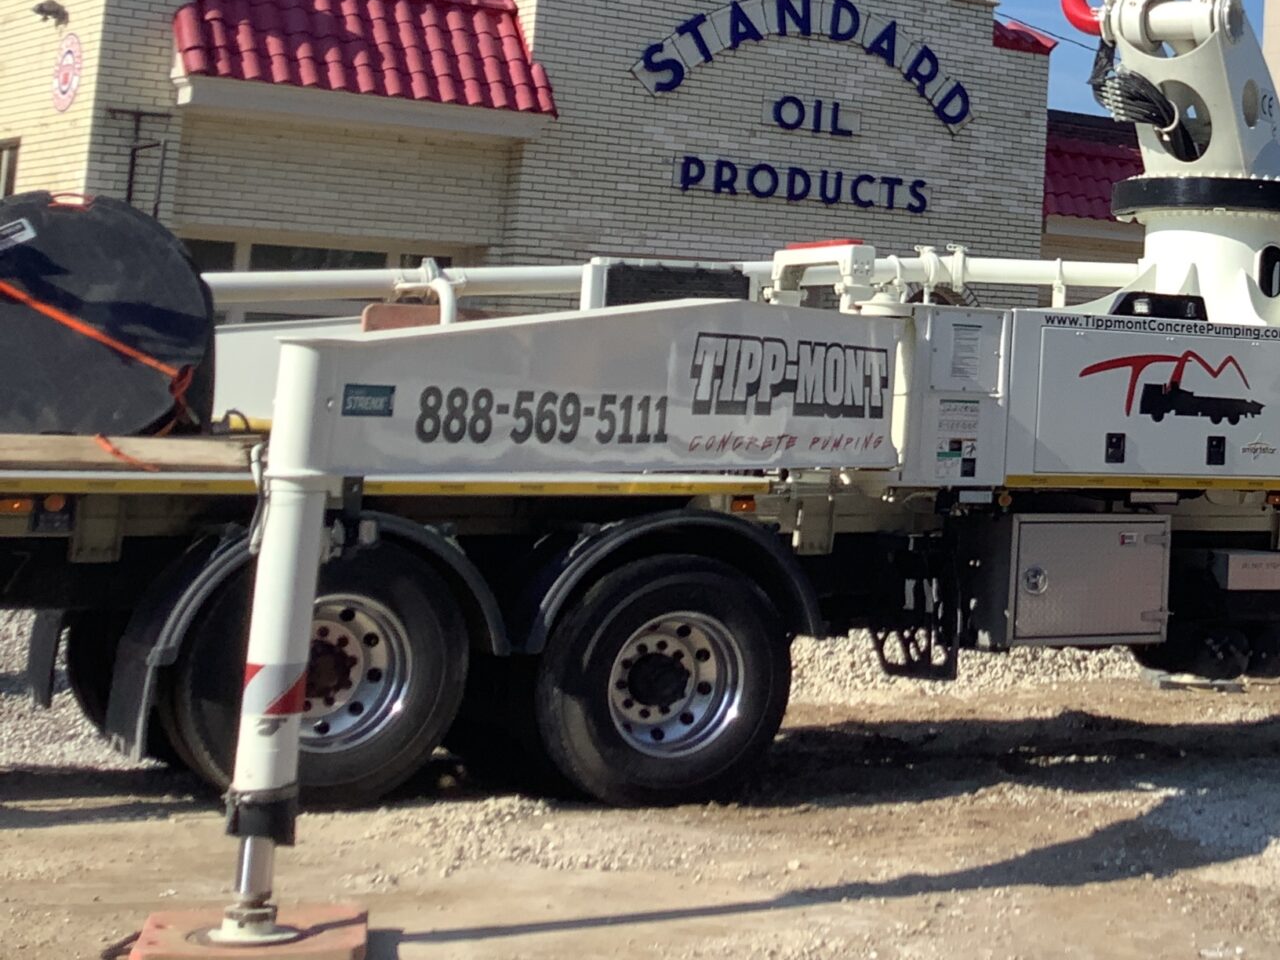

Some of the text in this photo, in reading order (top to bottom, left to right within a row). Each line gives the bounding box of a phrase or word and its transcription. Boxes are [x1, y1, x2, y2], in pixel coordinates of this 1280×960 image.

[773, 95, 853, 137] OIL
[680, 155, 928, 214] PRODUCTS
[690, 332, 889, 419] TIPP-MONT
[415, 384, 669, 445] 888-569-5111
[688, 431, 885, 453] CONCRETE PUMPING
